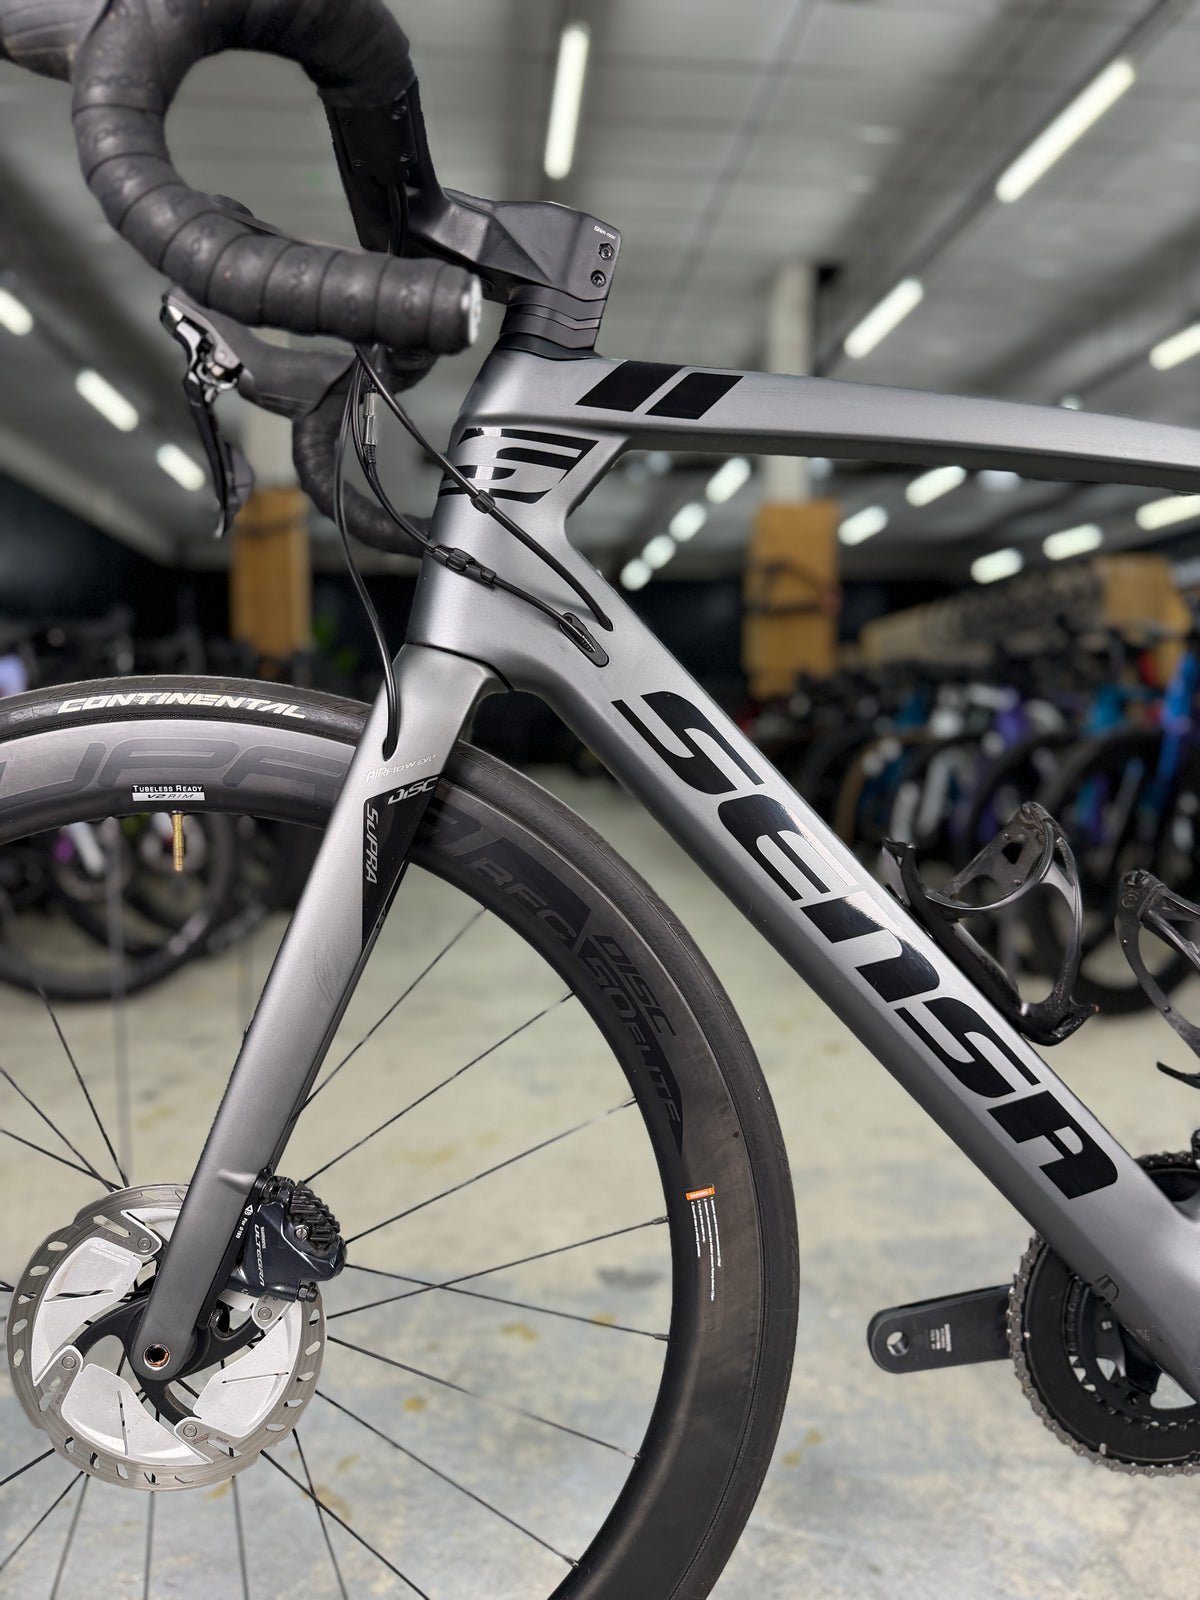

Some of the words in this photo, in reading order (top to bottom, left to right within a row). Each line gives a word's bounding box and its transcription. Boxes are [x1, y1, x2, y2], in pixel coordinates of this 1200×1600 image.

[57, 692, 307, 719] CONTINENTAL
[132, 785, 174, 793] TUBELESS
[175, 784, 203, 793] READY
[387, 776, 439, 805] DISC
[366, 802, 379, 885] SUPRA
[592, 933, 678, 1037] DISC
[254, 1223, 266, 1287] ULTEGRA
